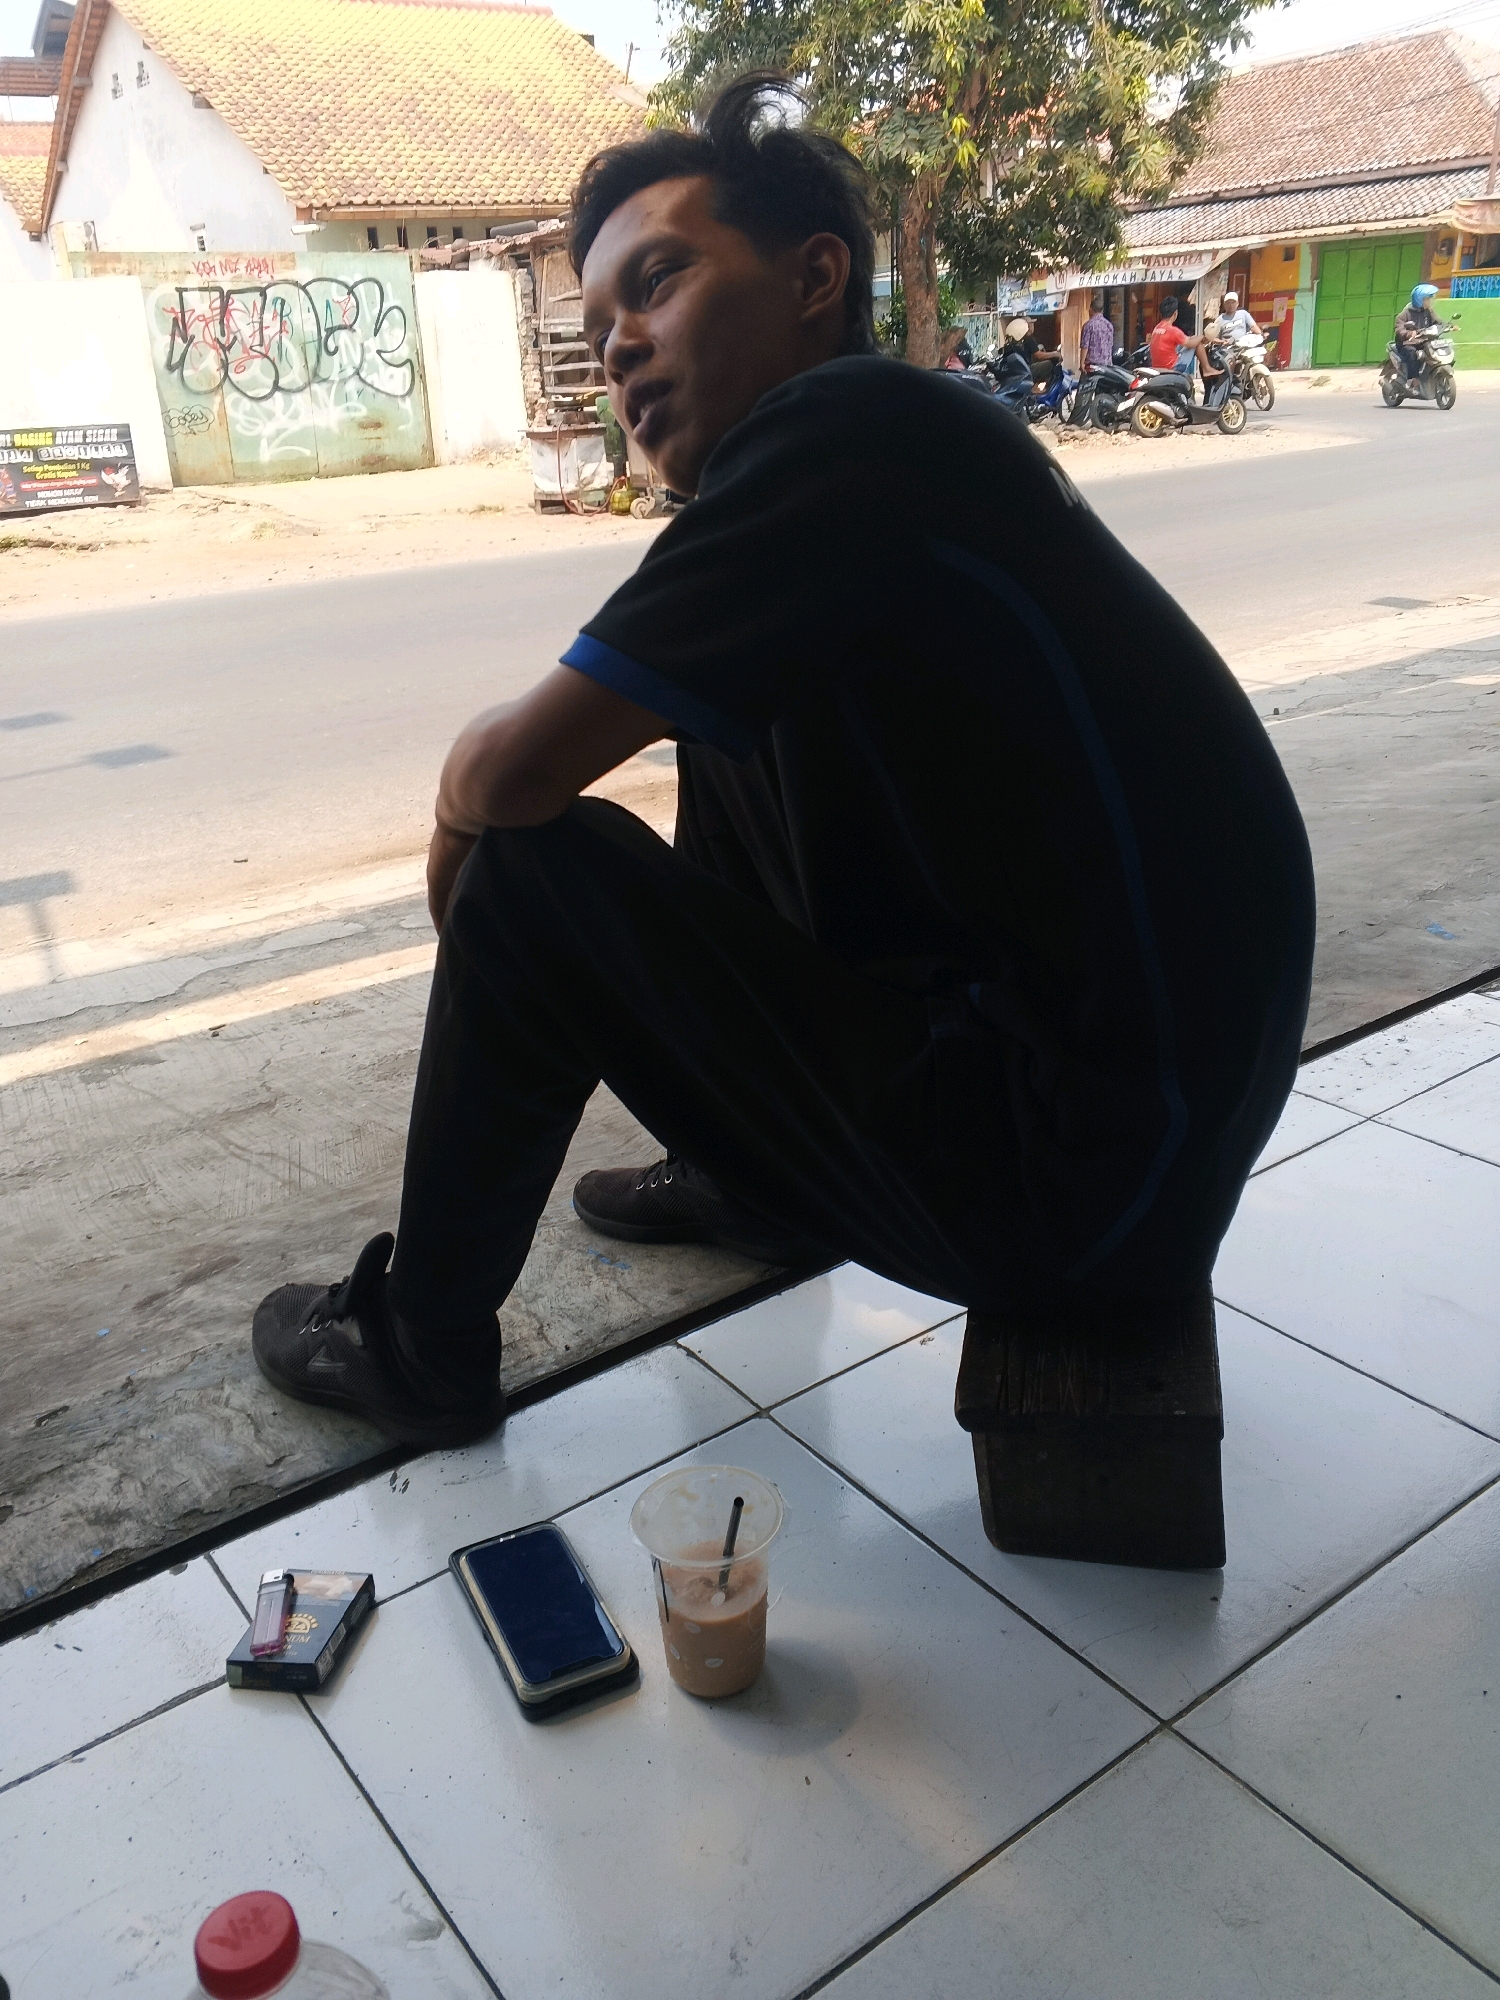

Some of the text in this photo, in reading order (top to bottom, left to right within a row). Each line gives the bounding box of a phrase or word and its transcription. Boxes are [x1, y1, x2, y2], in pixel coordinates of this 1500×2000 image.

[1079, 268, 1185, 287] BAROKAH JAYA 2
[55, 430, 83, 445] AYAM
[86, 428, 117, 443] SEGAR
[38, 443, 127, 460] BROILER
